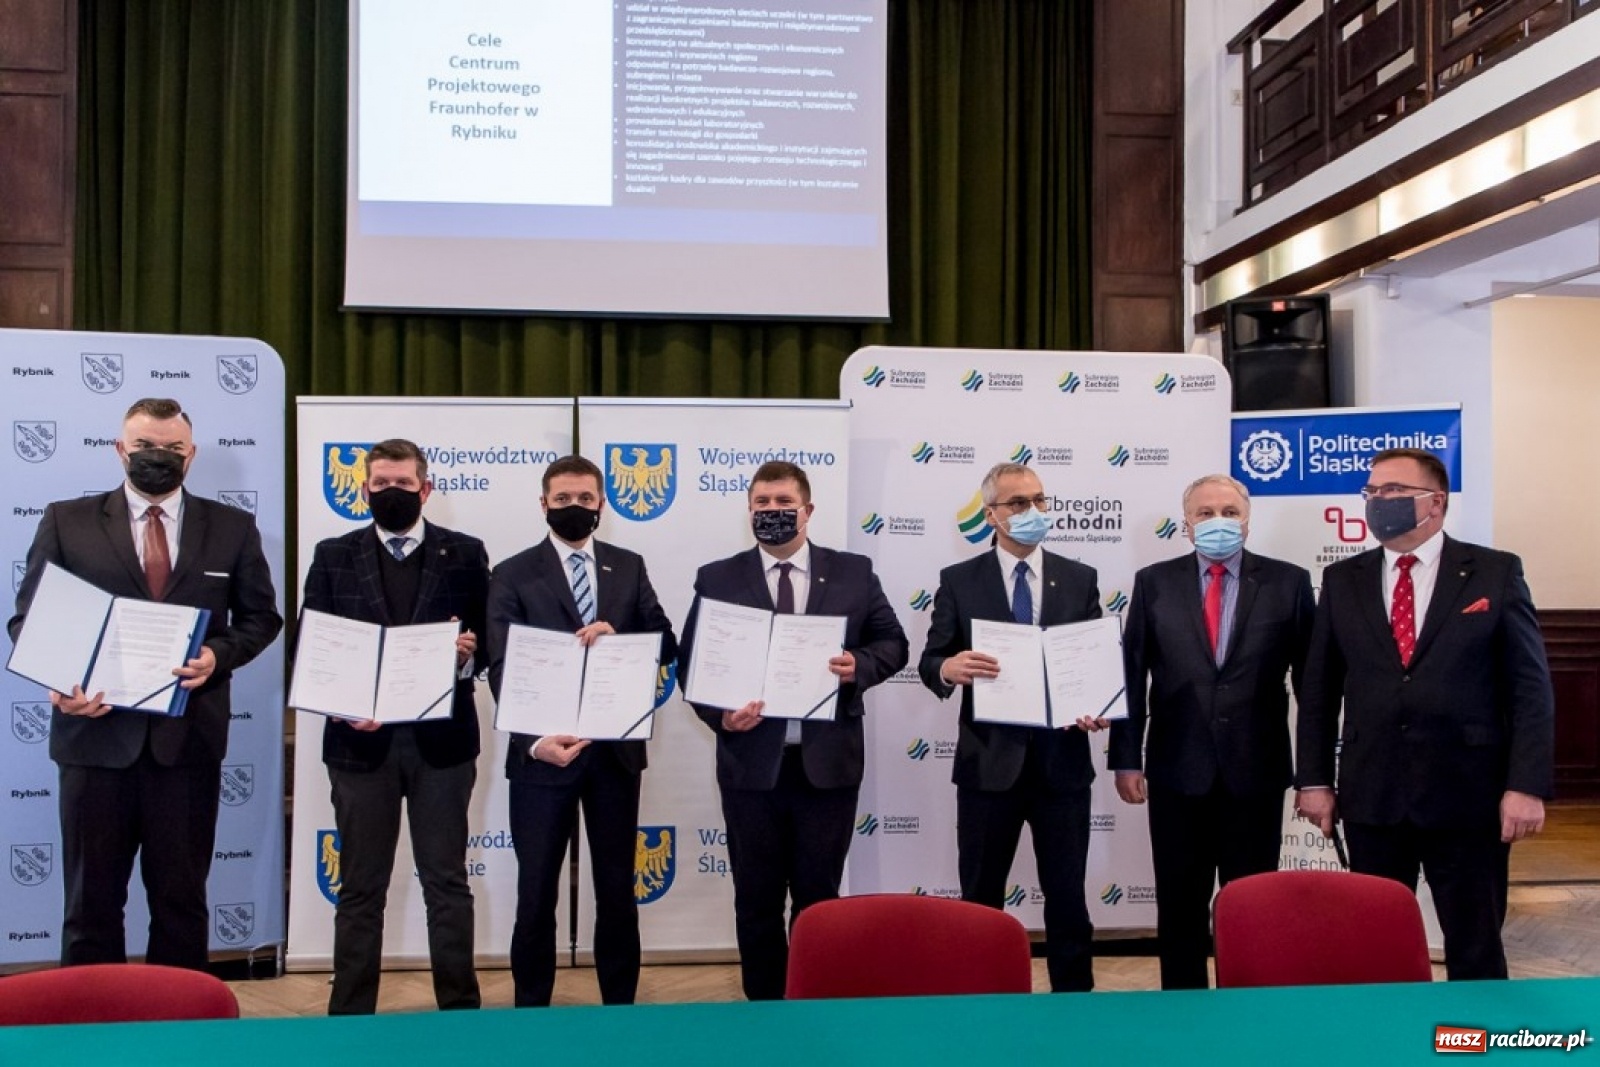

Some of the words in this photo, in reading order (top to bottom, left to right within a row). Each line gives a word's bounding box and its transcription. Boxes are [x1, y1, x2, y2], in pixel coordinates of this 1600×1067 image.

[467, 33, 502, 47] Cele
[449, 55, 520, 70] Centrum
[428, 77, 541, 96] Projektowego
[429, 100, 520, 116] Fraunhofer
[524, 106, 539, 117] w
[451, 124, 517, 141] Rybniku
[13, 367, 54, 378] Rybnik
[150, 370, 191, 380] Rybnik
[890, 376, 926, 384] Zachodni
[1180, 380, 1216, 388] Zachodni
[84, 438, 116, 446] Rybni
[219, 438, 256, 446] Rybnik
[1309, 432, 1447, 453] Politechnika
[420, 447, 558, 468] Województwo
[699, 447, 836, 469] Województwo
[427, 473, 490, 495] ląskie
[699, 472, 751, 496] Śląsk
[14, 507, 43, 516] Rybn
[1045, 495, 1122, 515] bregion
[1050, 513, 1122, 529] chodni
[230, 711, 253, 720] bnik
[11, 789, 51, 799] Rybnik
[215, 851, 253, 860] Rybnik
[9, 932, 51, 941] Rybnik
